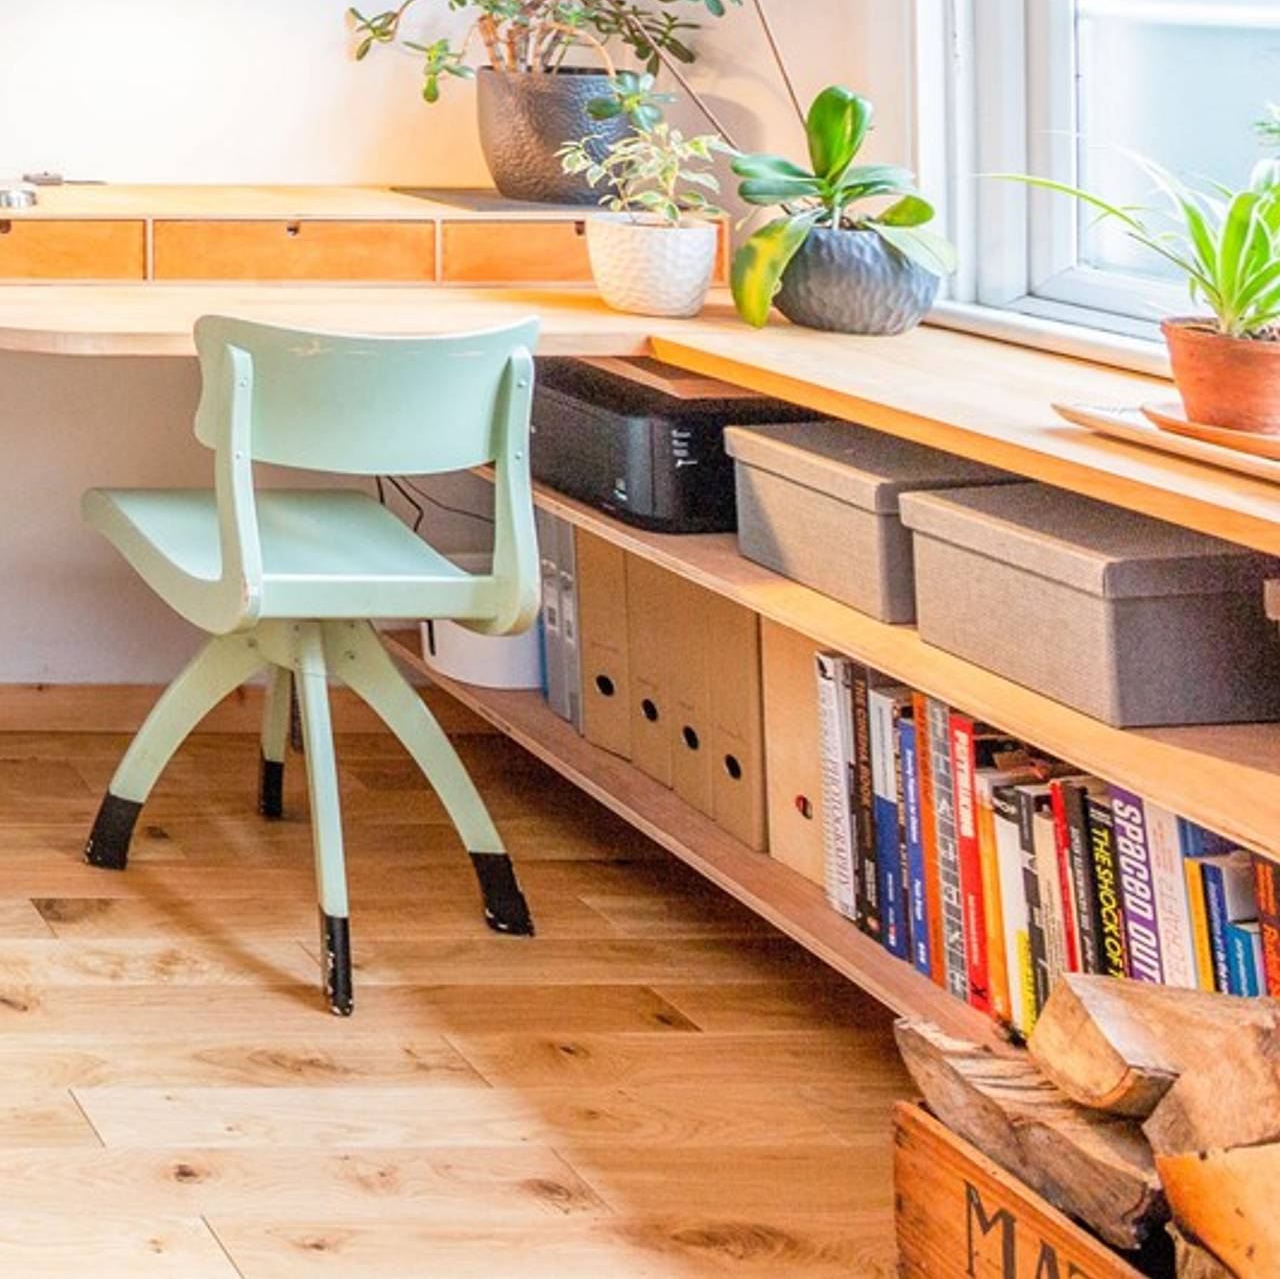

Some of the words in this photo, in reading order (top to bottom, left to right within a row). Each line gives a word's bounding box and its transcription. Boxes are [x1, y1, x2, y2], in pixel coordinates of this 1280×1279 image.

[854, 679, 867, 706] THE
[855, 708, 870, 762] CINEMA
[859, 764, 873, 808] BOOK
[829, 758, 852, 889] PHOTOGRAPHY
[1091, 827, 1111, 863] THE
[1096, 864, 1120, 937] SHOCK
[1103, 937, 1123, 966] OF
[1126, 921, 1161, 983] OUT
[964, 1179, 1093, 1279] MA
